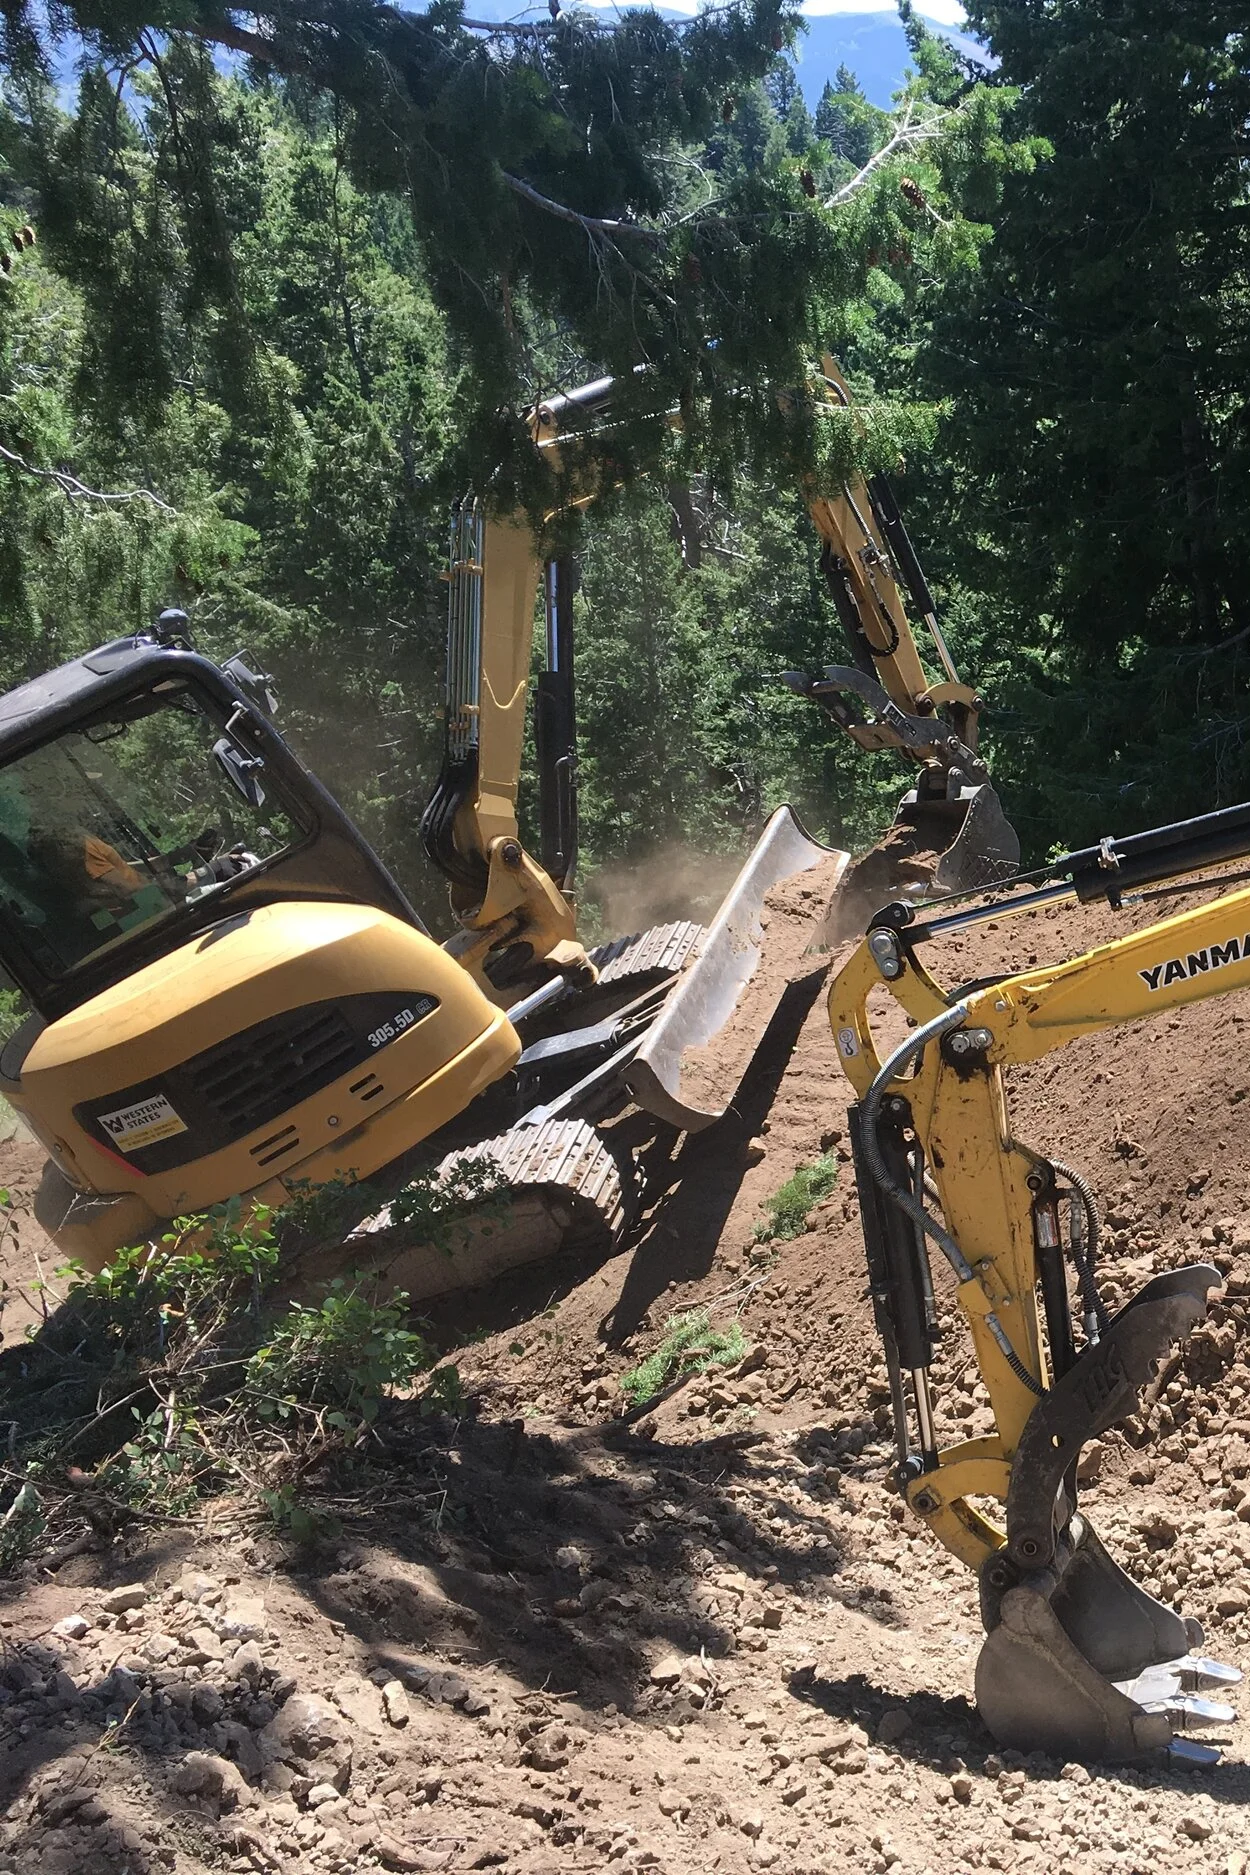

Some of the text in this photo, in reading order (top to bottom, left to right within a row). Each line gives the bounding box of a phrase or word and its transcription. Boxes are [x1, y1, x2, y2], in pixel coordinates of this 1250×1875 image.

[367, 1008, 415, 1048] 305.5D
[120, 1099, 168, 1121] WESTERN
[127, 1111, 161, 1129] STATES
